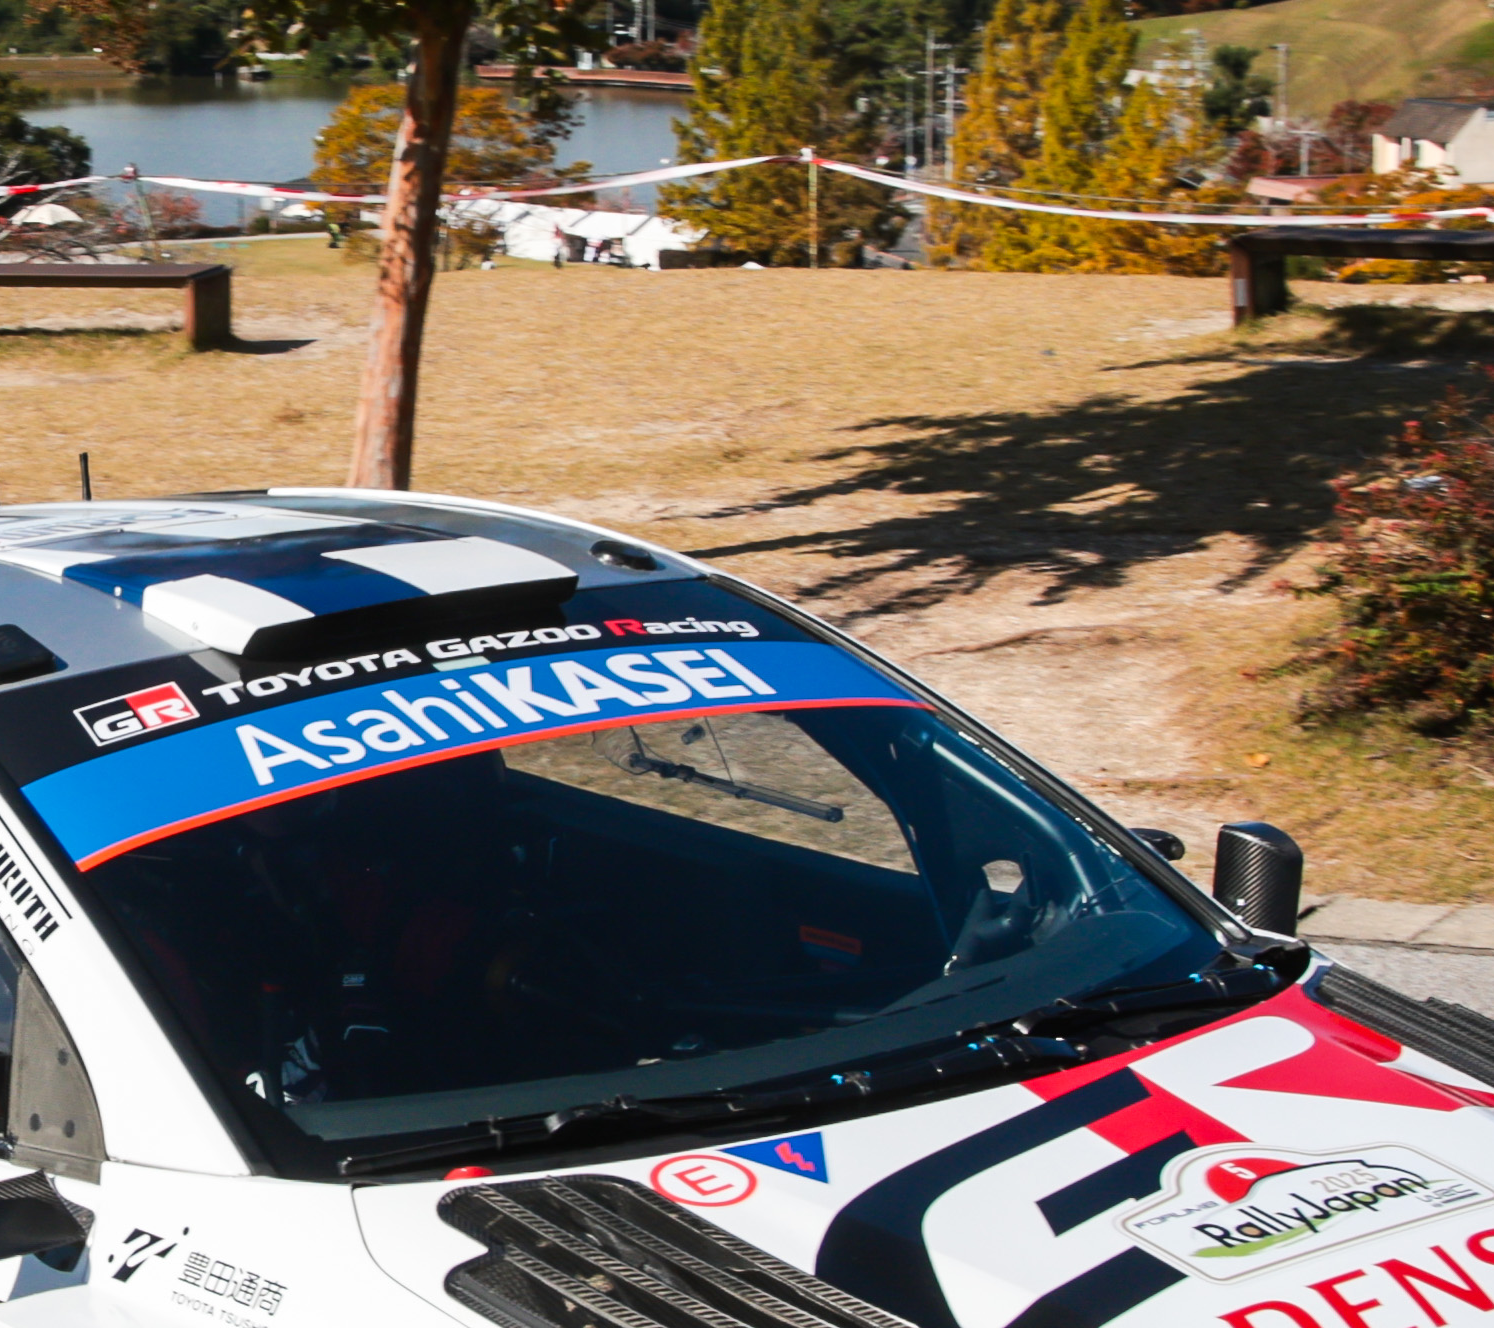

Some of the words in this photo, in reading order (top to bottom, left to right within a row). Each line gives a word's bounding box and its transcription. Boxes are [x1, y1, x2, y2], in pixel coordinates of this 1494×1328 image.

[90, 694, 195, 743] GR
[202, 648, 422, 705] TOYOTA
[425, 623, 602, 660] GAZOO
[603, 617, 761, 638] Racing
[235, 648, 778, 786] AsahiKASEI
[672, 1165, 736, 1197] E
[1219, 1161, 1257, 1180] 5
[1311, 1168, 1379, 1194] 2025
[178, 1250, 288, 1317] 豊田通商
[170, 1290, 214, 1316] TOYOTA
